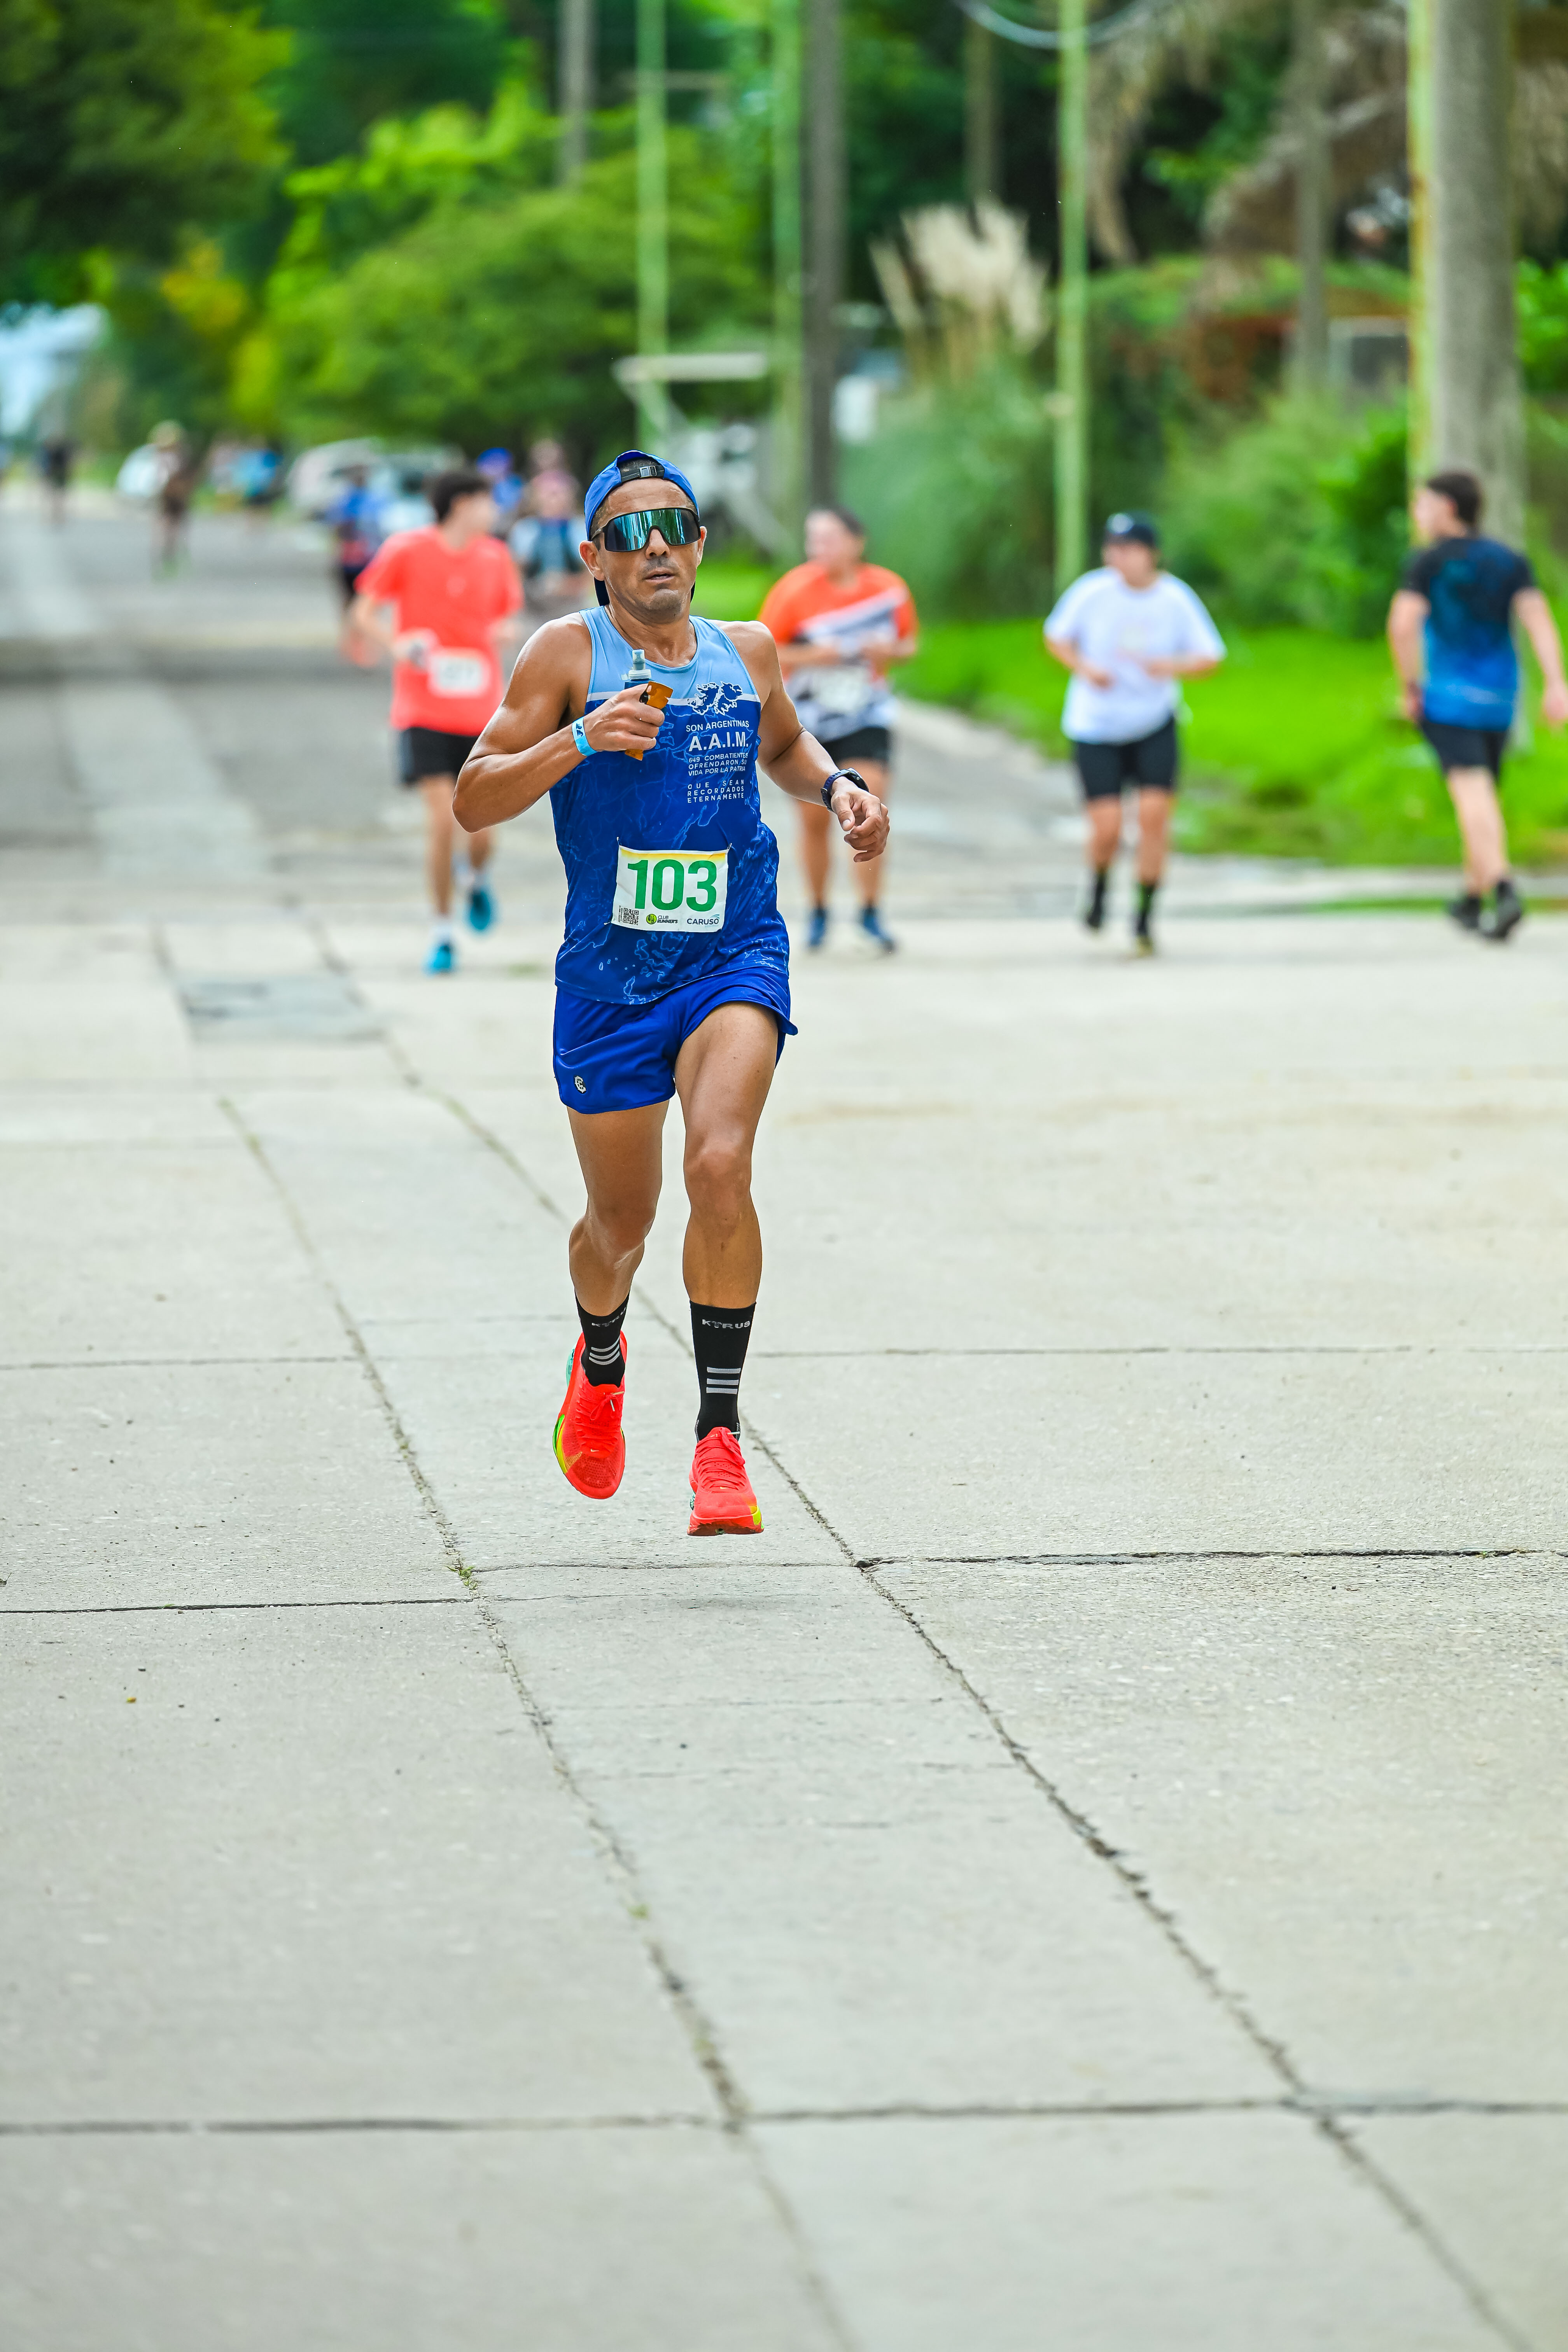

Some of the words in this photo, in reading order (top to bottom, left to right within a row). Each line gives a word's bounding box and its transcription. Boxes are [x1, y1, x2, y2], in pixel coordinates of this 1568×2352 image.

[686, 724, 703, 732] SON
[705, 720, 749, 730] ARGENTINAS
[689, 732, 748, 752] A.A.I.M.
[704, 752, 748, 761] COMBATIENTES
[688, 760, 738, 770] OFRENDARON
[687, 786, 744, 796] RECORDADOS
[687, 793, 744, 803] ETERNAMENTE
[627, 859, 717, 912] 103
